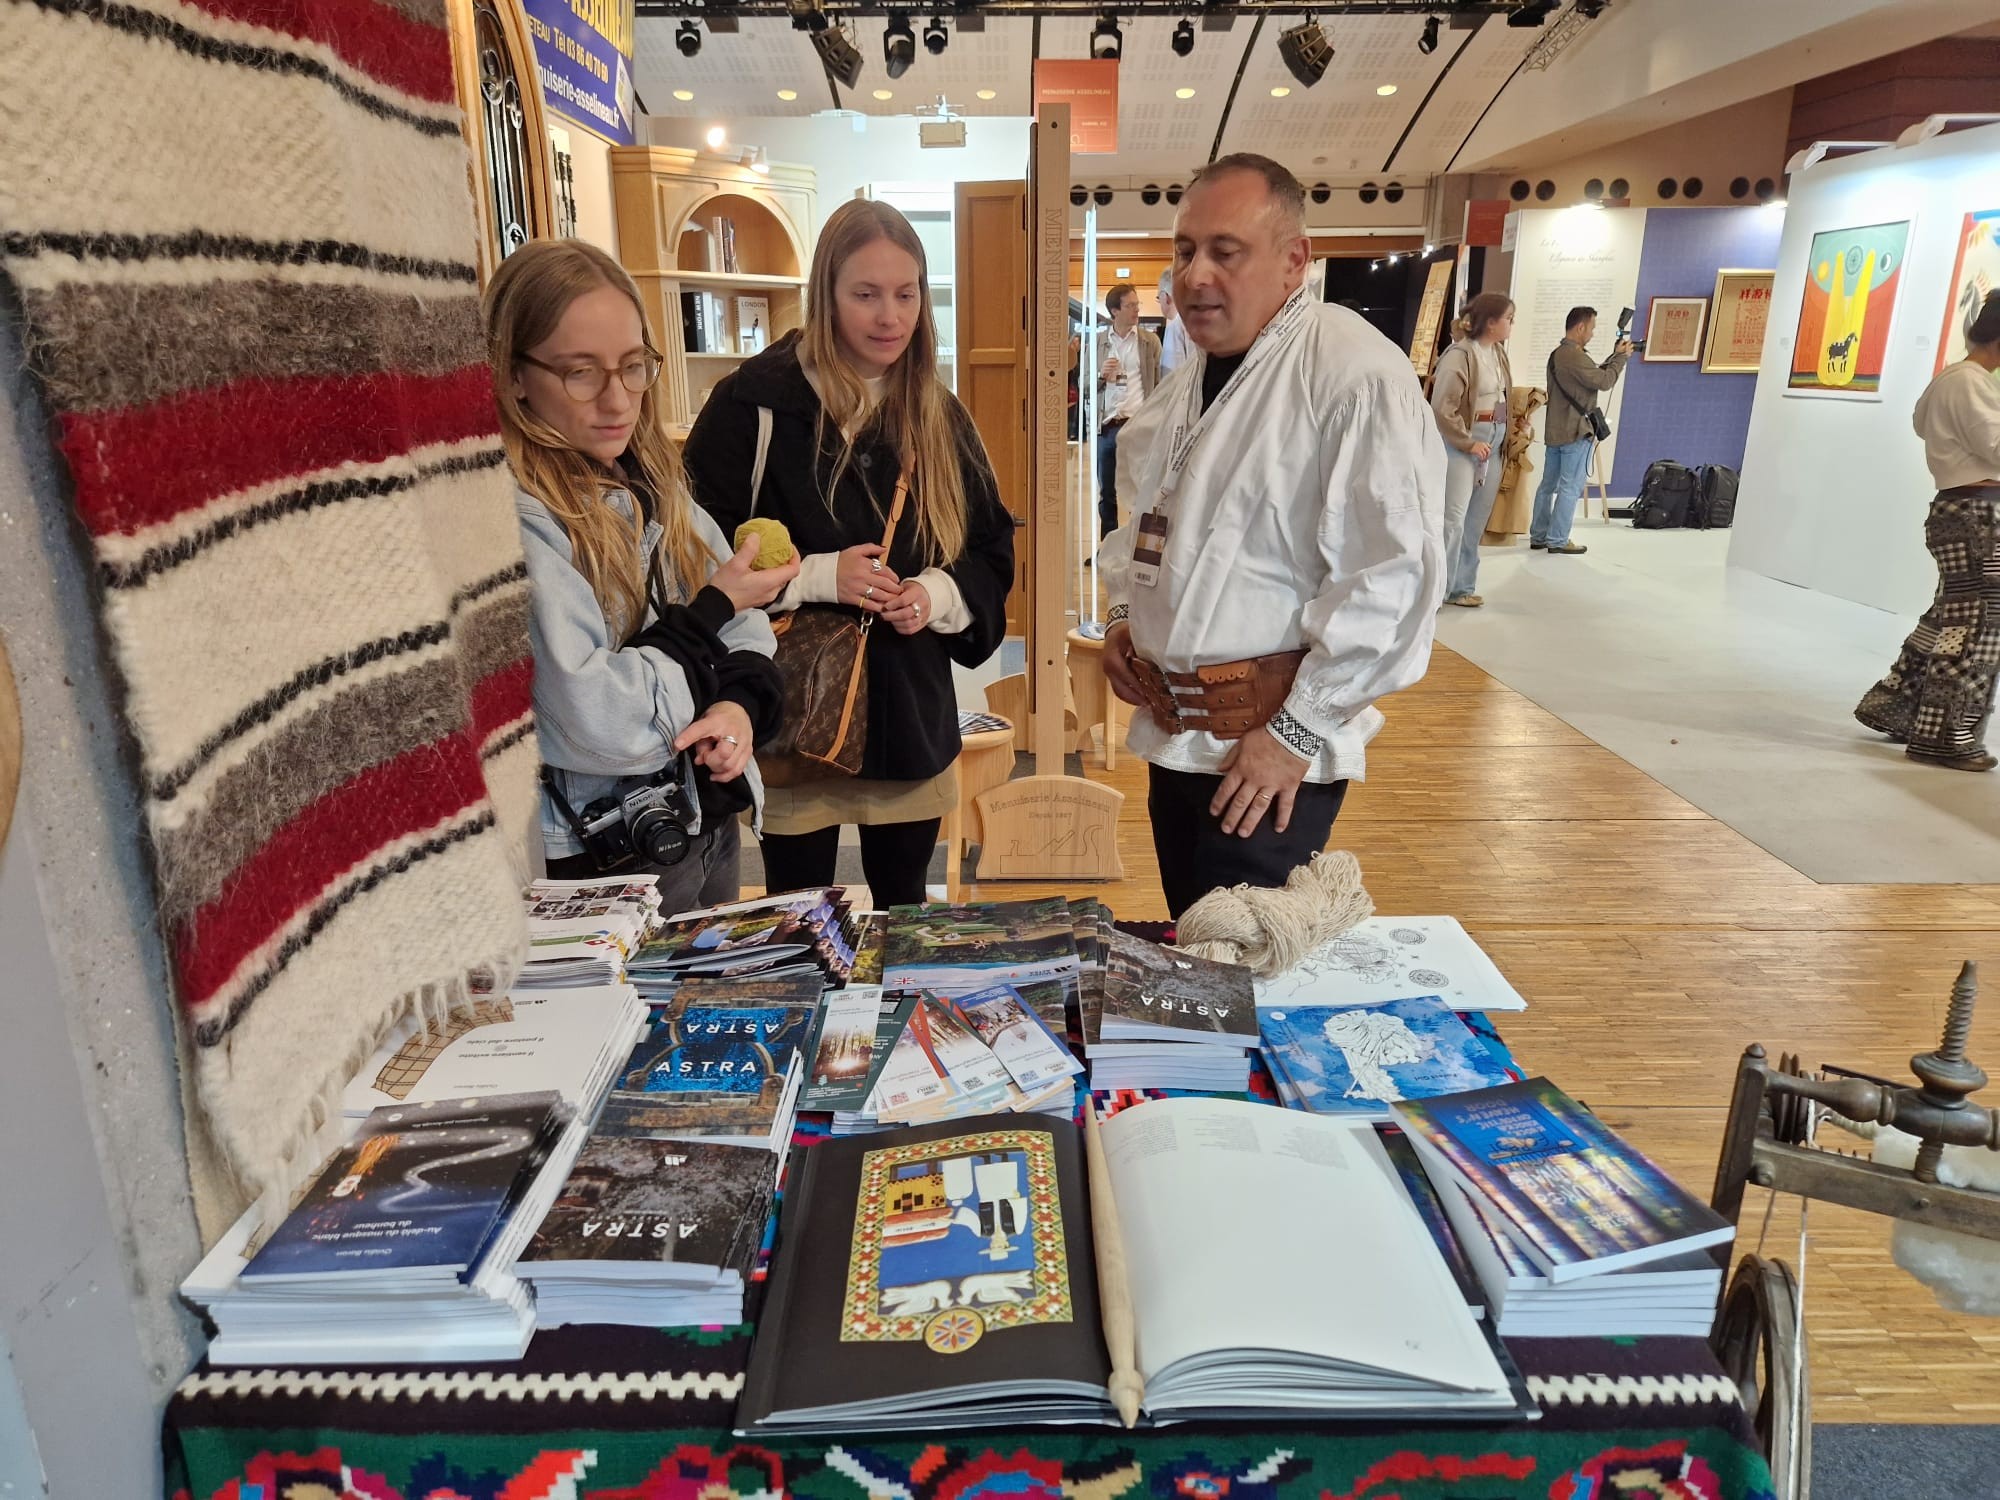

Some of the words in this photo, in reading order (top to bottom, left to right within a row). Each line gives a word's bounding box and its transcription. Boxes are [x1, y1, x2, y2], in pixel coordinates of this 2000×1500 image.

[553, 27, 566, 54] Tél
[566, 37, 576, 60] 03
[1044, 208, 1062, 370] MENUISERIE
[1043, 377, 1062, 526] ASSELINEAU
[630, 794, 654, 808] Nikon
[658, 842, 682, 852] Nikon
[1140, 995, 1229, 1018] ASTRA
[686, 1023, 780, 1034] ASTRA
[654, 1061, 756, 1072] ASTRA
[352, 1221, 396, 1230] bonheur
[401, 1226, 442, 1236] Au-delà
[582, 1222, 698, 1239] ASTRA
[342, 1230, 384, 1238] masque
[385, 1229, 399, 1238] du
